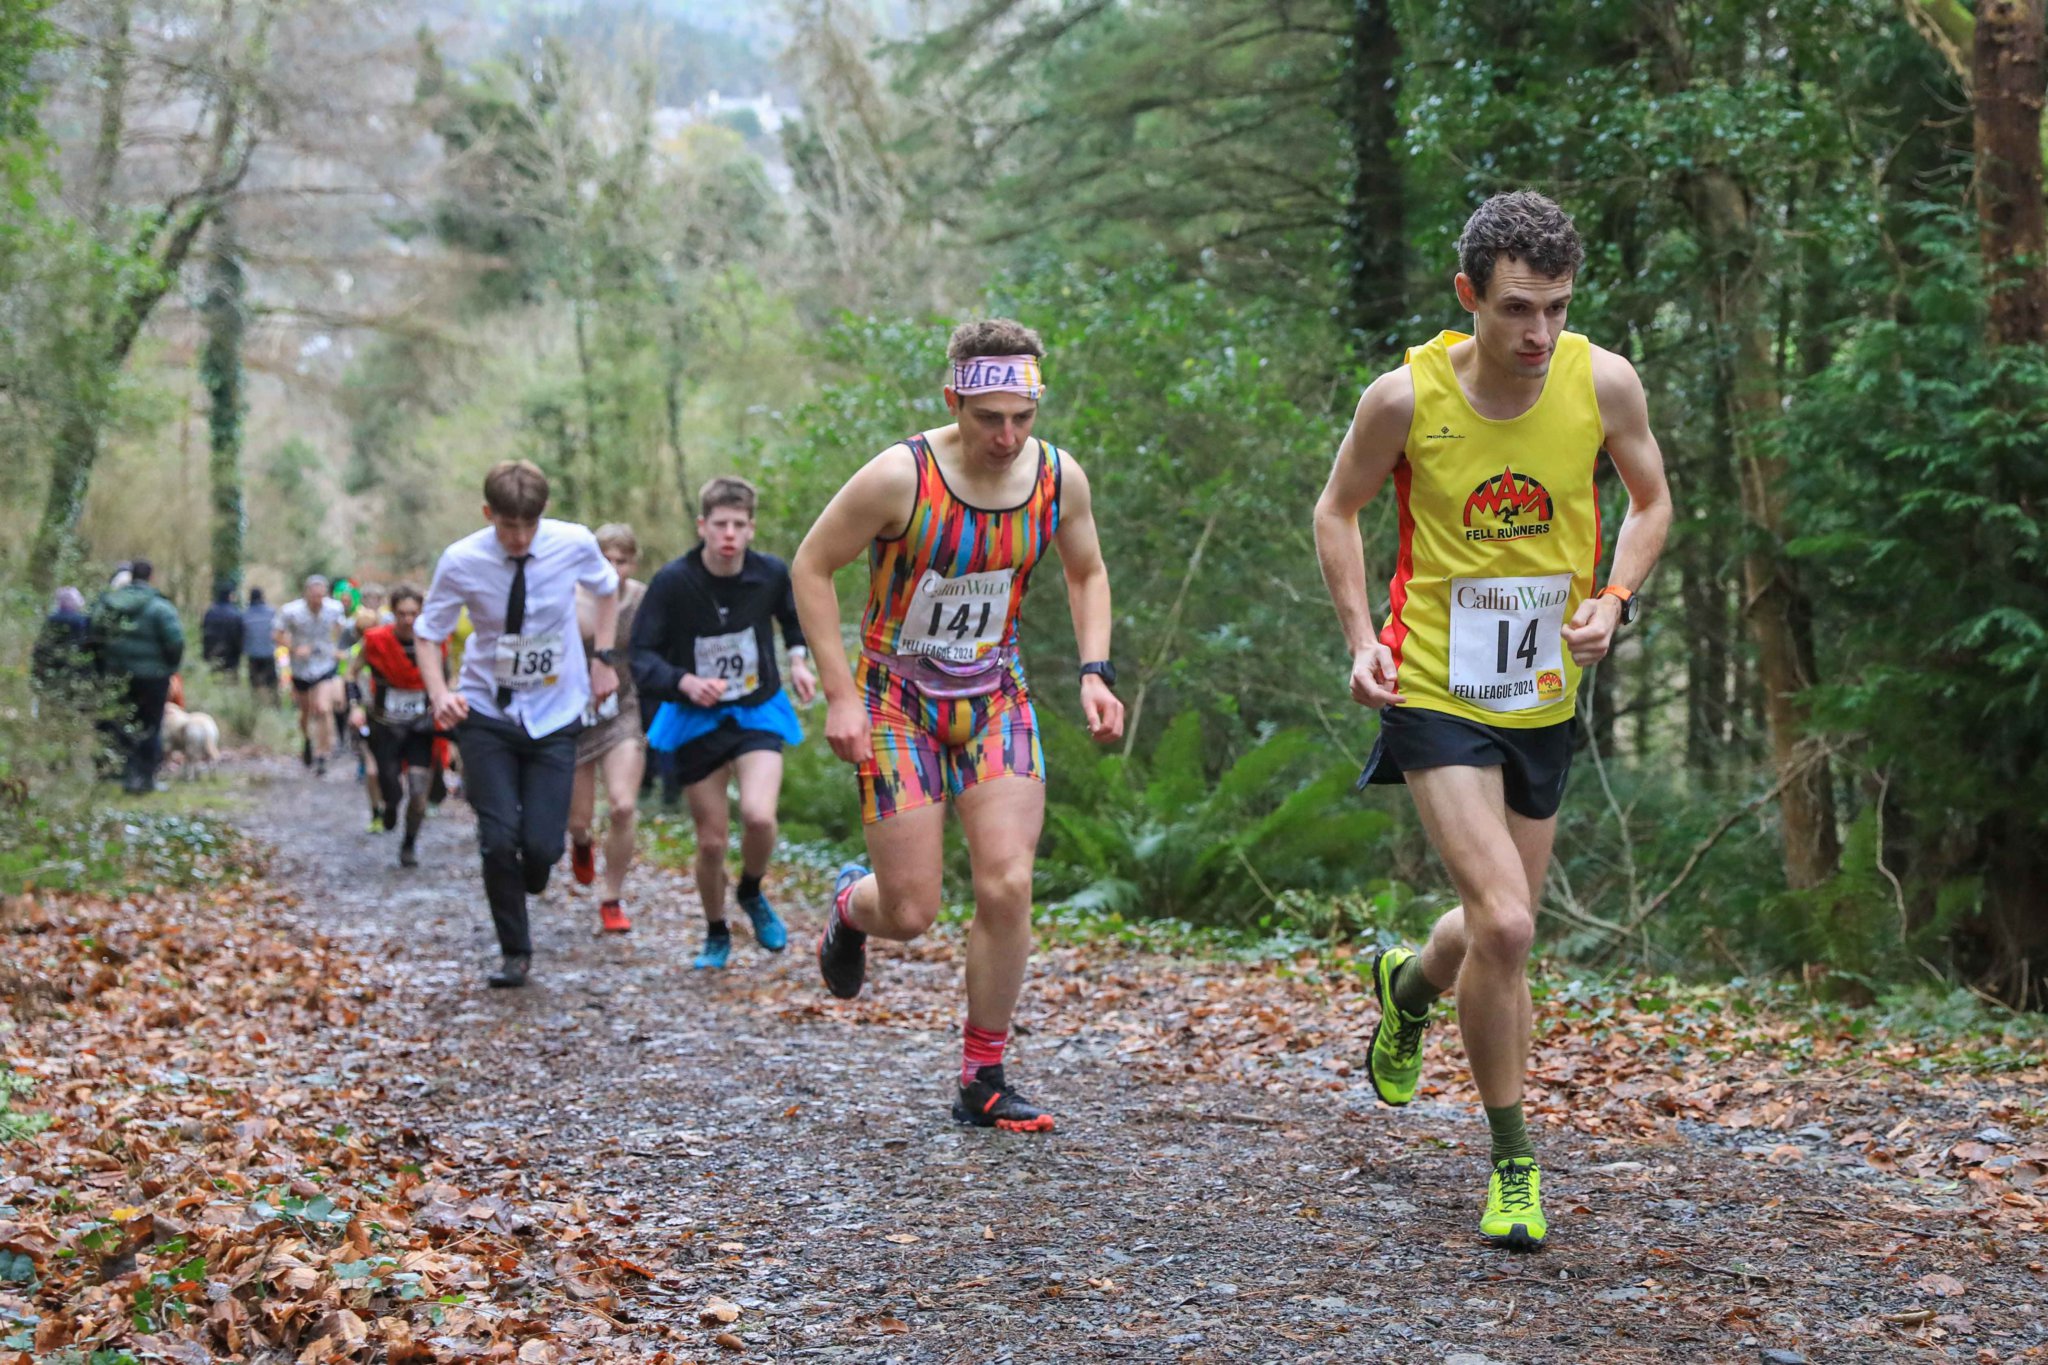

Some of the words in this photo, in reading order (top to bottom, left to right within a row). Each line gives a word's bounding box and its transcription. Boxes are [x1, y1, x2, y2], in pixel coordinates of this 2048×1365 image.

[1466, 530, 1494, 541] FELL
[1497, 523, 1550, 539] RUNNERS
[927, 602, 991, 640] 141
[921, 642, 951, 659] LEAGUE
[953, 646, 973, 659] 2024
[1497, 618, 1539, 673] 14
[512, 649, 553, 676] 138
[716, 655, 744, 679] 29
[1454, 684, 1476, 699] FELL
[1479, 683, 1512, 700] LEAGUE
[1513, 679, 1534, 697] 2024
